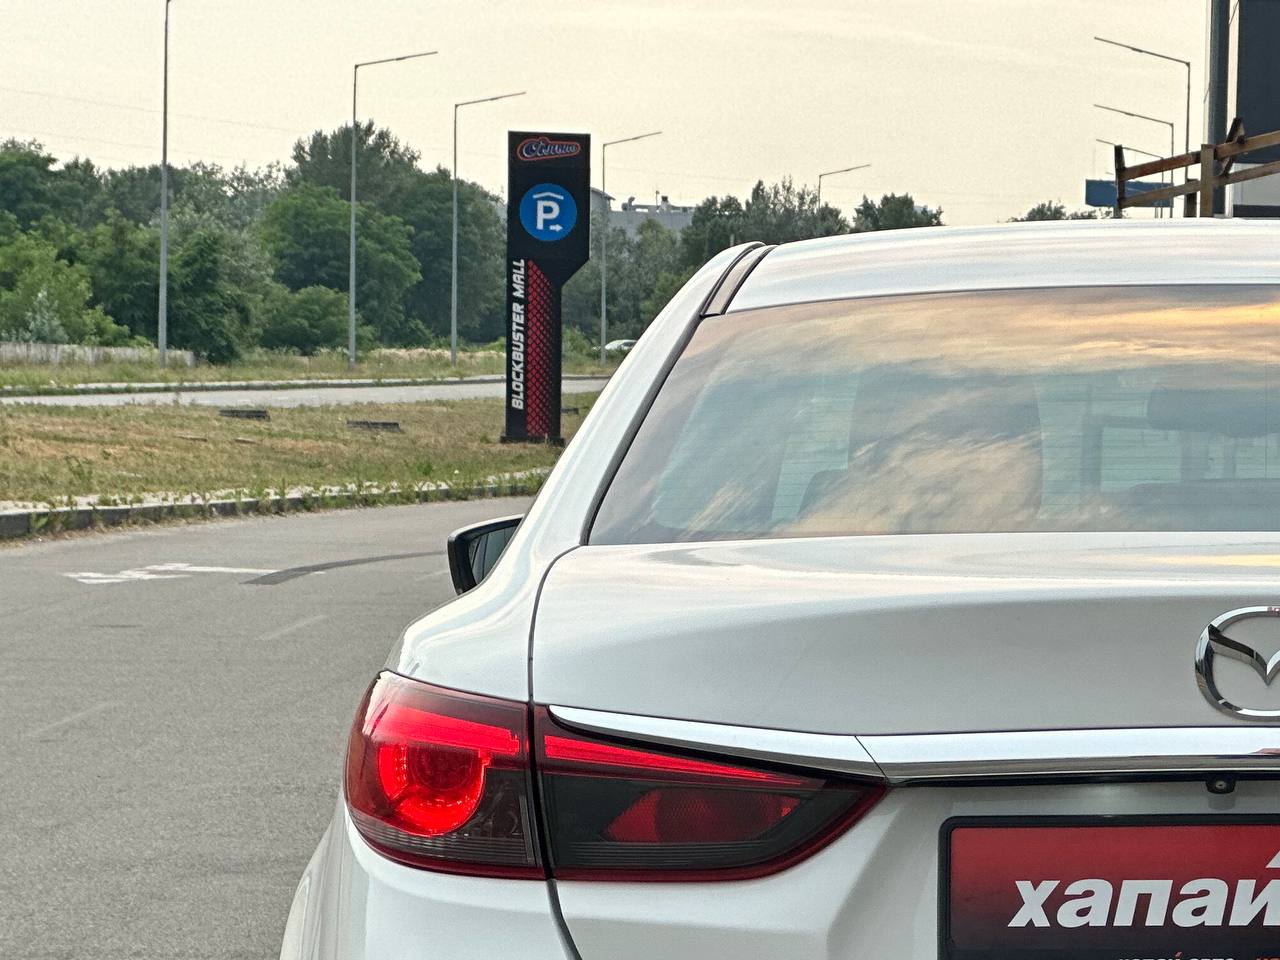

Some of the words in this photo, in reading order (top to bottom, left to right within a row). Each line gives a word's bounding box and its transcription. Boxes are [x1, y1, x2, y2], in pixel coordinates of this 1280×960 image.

[536, 201, 560, 230] P
[512, 258, 525, 299] MALL
[512, 305, 525, 410] BLOCKBUSTER
